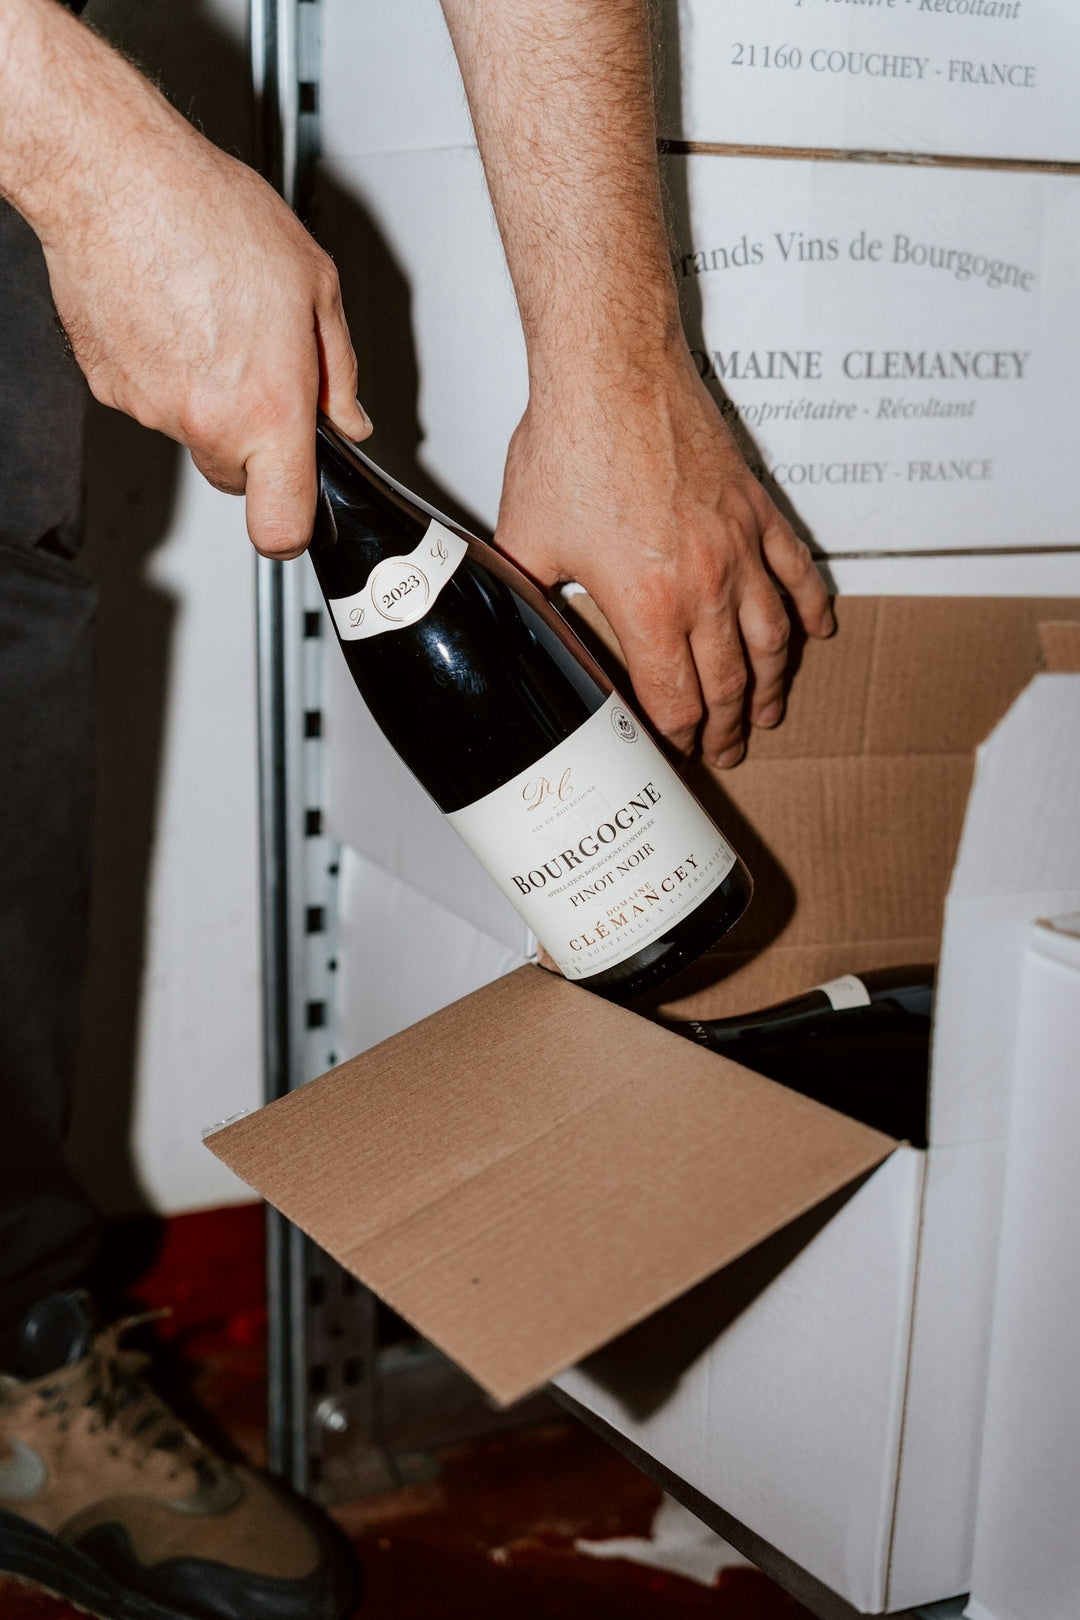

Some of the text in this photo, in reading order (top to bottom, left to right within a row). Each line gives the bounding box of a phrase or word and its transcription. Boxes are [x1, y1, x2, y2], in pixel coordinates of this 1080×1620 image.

[731, 43, 801, 70] 21160
[810, 48, 930, 80] COUCHEY
[948, 60, 1038, 88] FRANCE
[674, 231, 1036, 293] rands Vins de Bourgogne
[689, 350, 1031, 380] OMAINE CLEMANCEY
[875, 398, 976, 421] Récoltant
[770, 461, 889, 486] COUCHEY
[907, 459, 994, 482] FRANCE
[382, 575, 420, 609] 2023
[511, 782, 662, 895] BOURGOGNE
[569, 842, 656, 908] PINOT NOIR
[569, 855, 699, 951] CLÉMANCEY
[606, 882, 652, 917] DOMAINE
